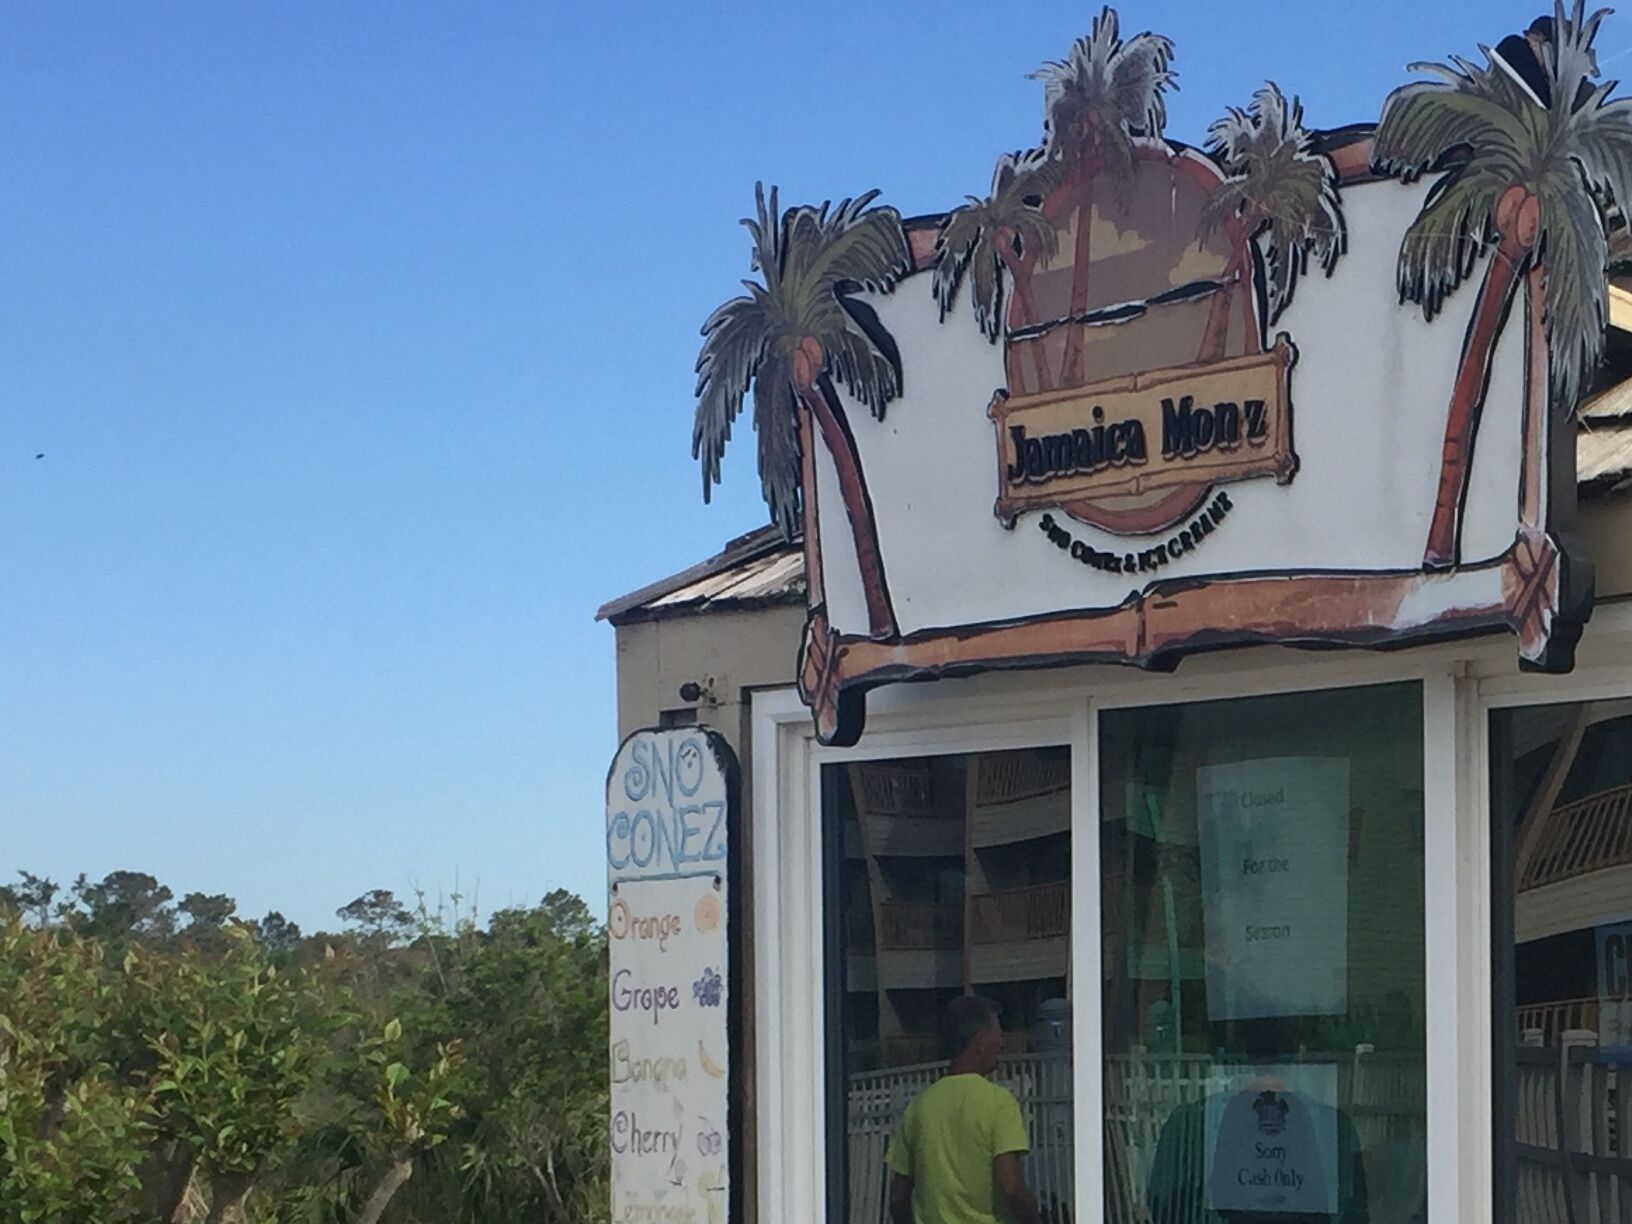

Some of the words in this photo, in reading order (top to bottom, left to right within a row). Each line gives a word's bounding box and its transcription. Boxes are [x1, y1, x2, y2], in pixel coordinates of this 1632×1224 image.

[1008, 406, 1148, 482] Jamaica
[1123, 552, 1137, 573] &
[624, 738, 703, 808] SNO
[1241, 788, 1284, 808] Closed
[607, 801, 726, 872] CONEZ
[1243, 856, 1265, 875] For
[1268, 855, 1290, 873] the
[610, 899, 681, 952] Orange
[1245, 924, 1290, 942] Season
[612, 969, 680, 1025] Grape
[612, 1110, 683, 1170] Cherry
[1255, 1142, 1287, 1167] Sorry
[1238, 1168, 1271, 1186] Cash
[1274, 1168, 1305, 1190] Only
